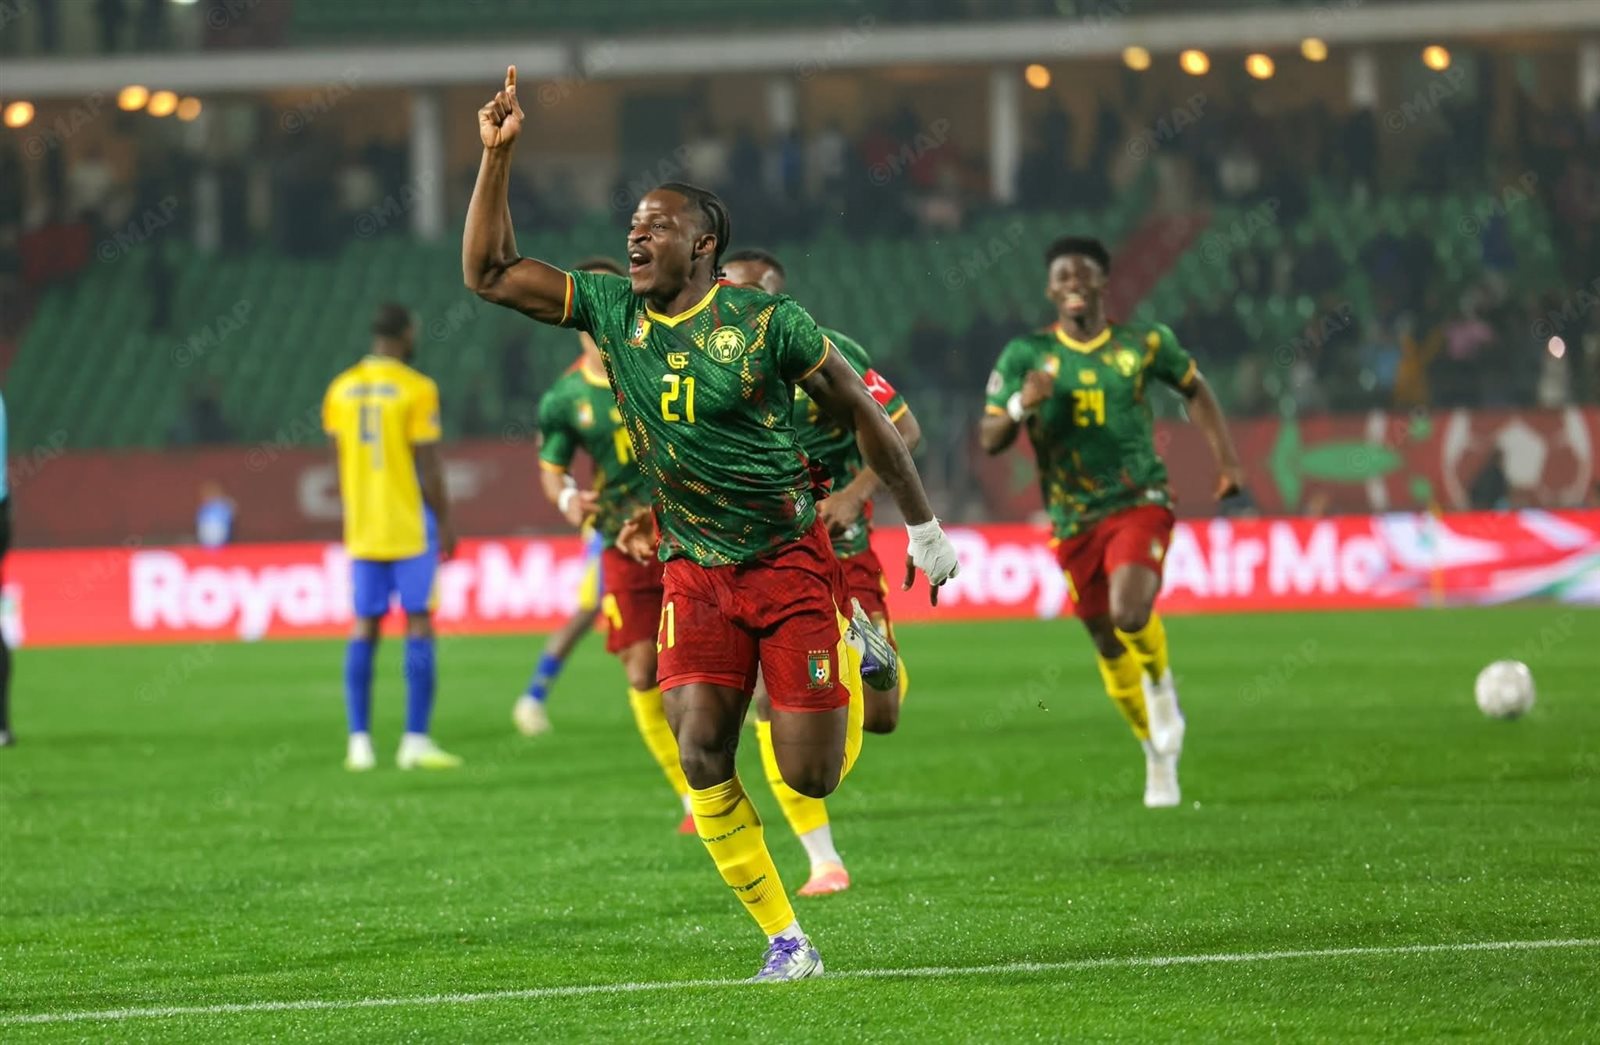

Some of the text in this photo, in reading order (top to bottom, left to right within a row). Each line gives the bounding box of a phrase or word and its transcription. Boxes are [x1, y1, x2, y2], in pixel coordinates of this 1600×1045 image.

[661, 374, 695, 423] 21
[1072, 388, 1105, 428] 24
[1162, 517, 1265, 598] Air
[129, 543, 351, 641] Royal
